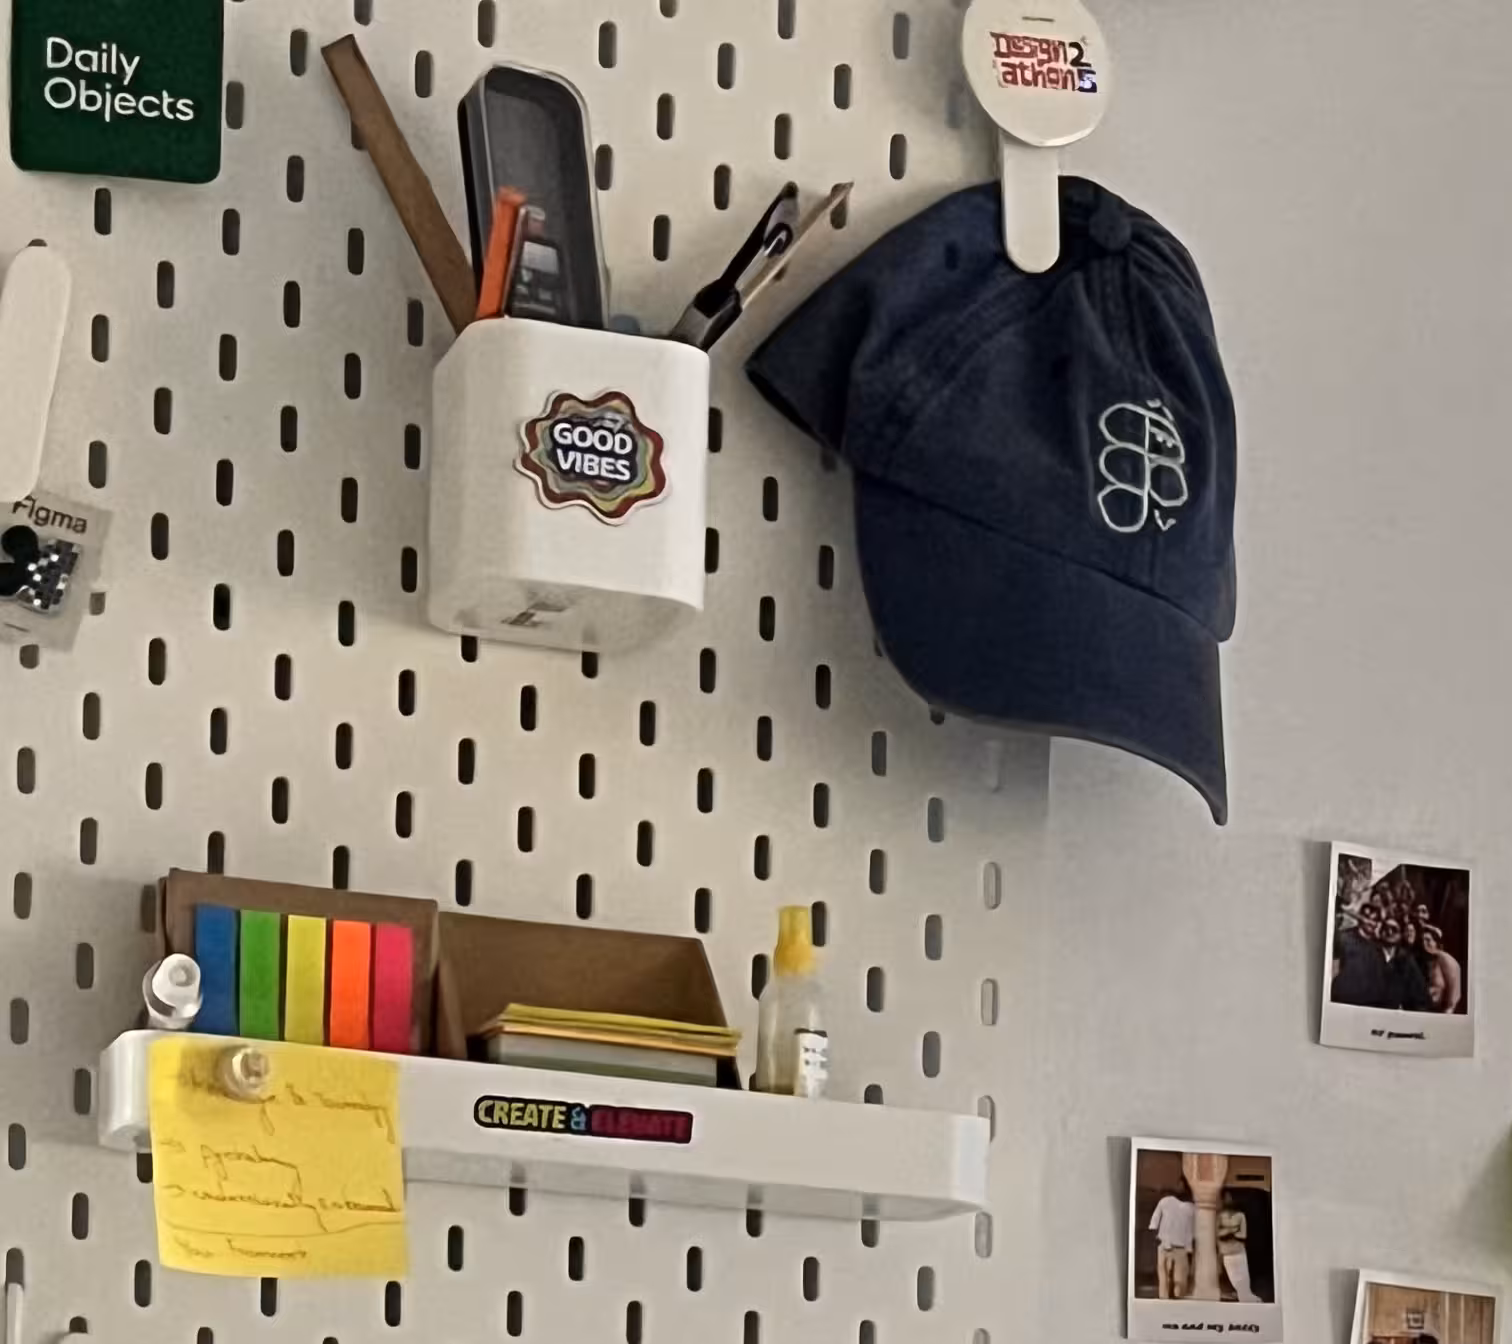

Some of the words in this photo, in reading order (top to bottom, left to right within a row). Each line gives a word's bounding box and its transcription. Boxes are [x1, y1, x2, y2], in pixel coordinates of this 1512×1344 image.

[46, 36, 141, 86] Daily
[43, 76, 196, 123] Objects
[552, 422, 633, 455] GOOD
[555, 448, 632, 481] VIBES
[477, 1099, 567, 1130] CREATE
